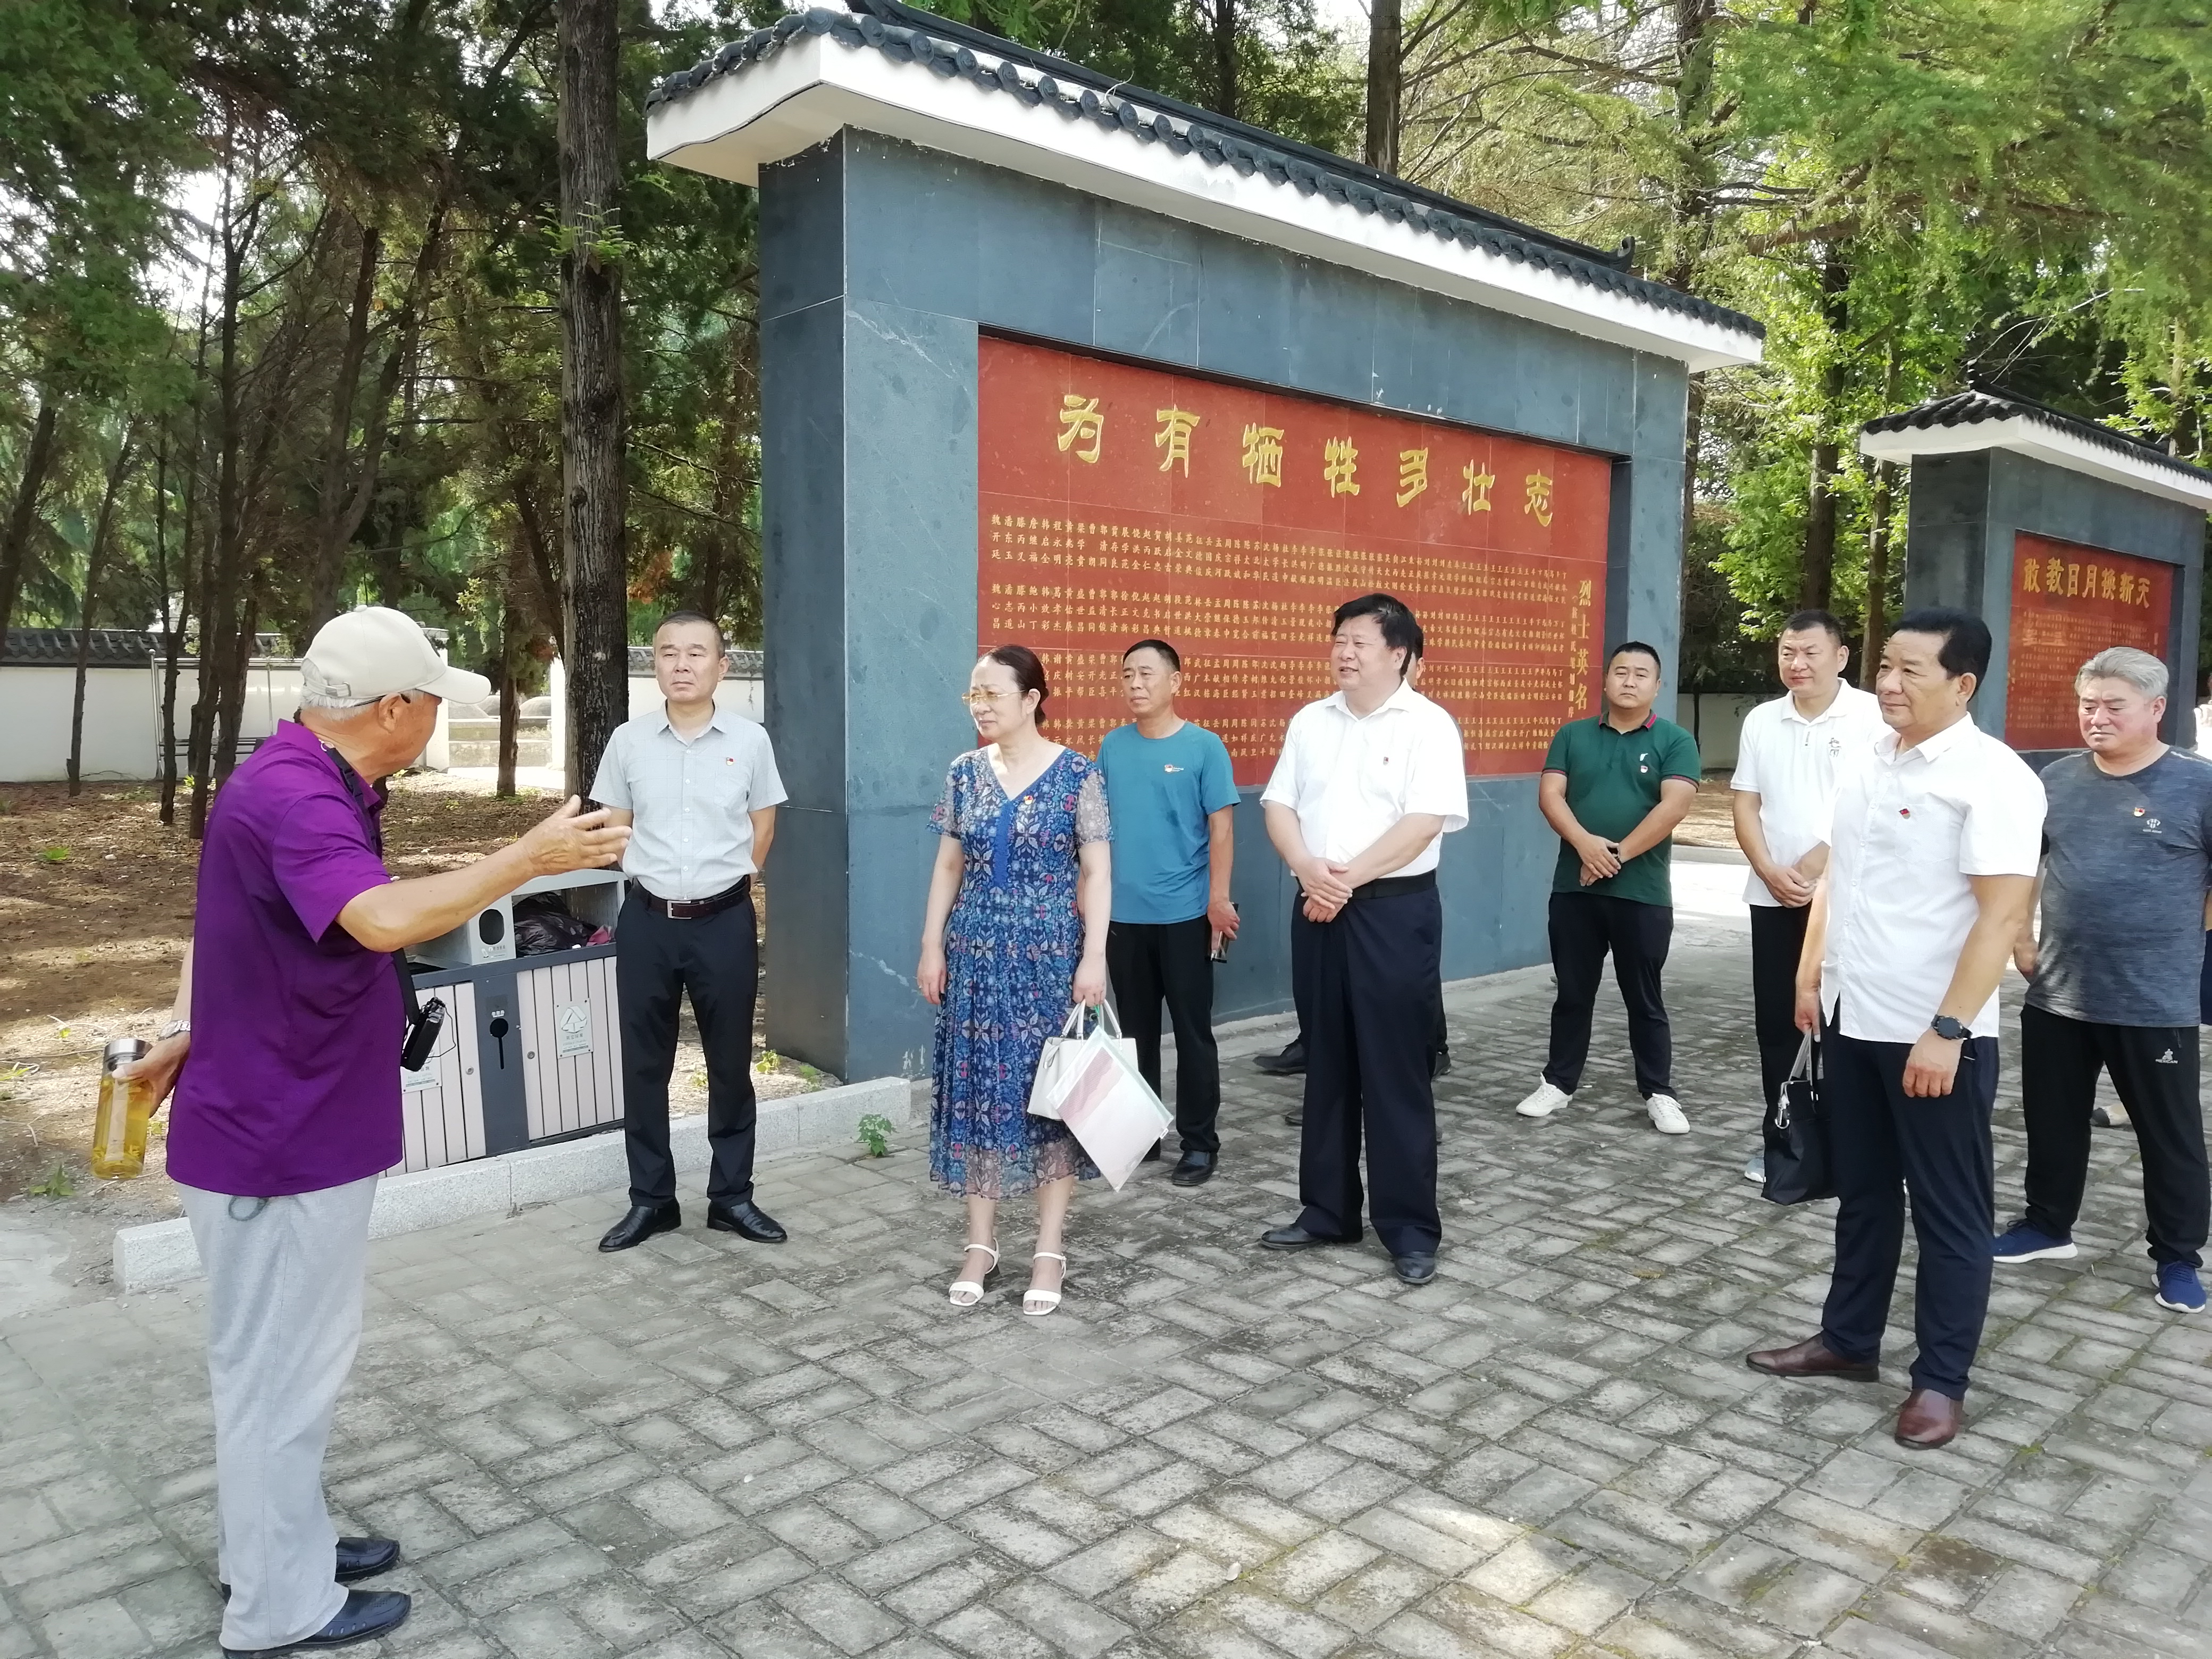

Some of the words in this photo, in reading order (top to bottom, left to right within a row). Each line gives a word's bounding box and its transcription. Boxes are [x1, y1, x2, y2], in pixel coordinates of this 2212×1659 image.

[1058, 394, 1553, 526] 为有牺牲多壮志
[991, 514, 1000, 559] 魏开廷
[1041, 518, 1050, 563] 韩启全
[1053, 521, 1062, 564] 程永明
[1142, 529, 1151, 570] 赵丙仁
[2023, 557, 2151, 608] 敢教日月换新天
[992, 583, 1000, 629] 魏心昌
[1004, 583, 1013, 629] 潘志道
[1029, 585, 1037, 629] 鲍小丁
[1052, 586, 1061, 631] 葛孝杰
[1076, 588, 1085, 632] 盛世昌
[1575, 580, 1591, 710] 烈士英名
